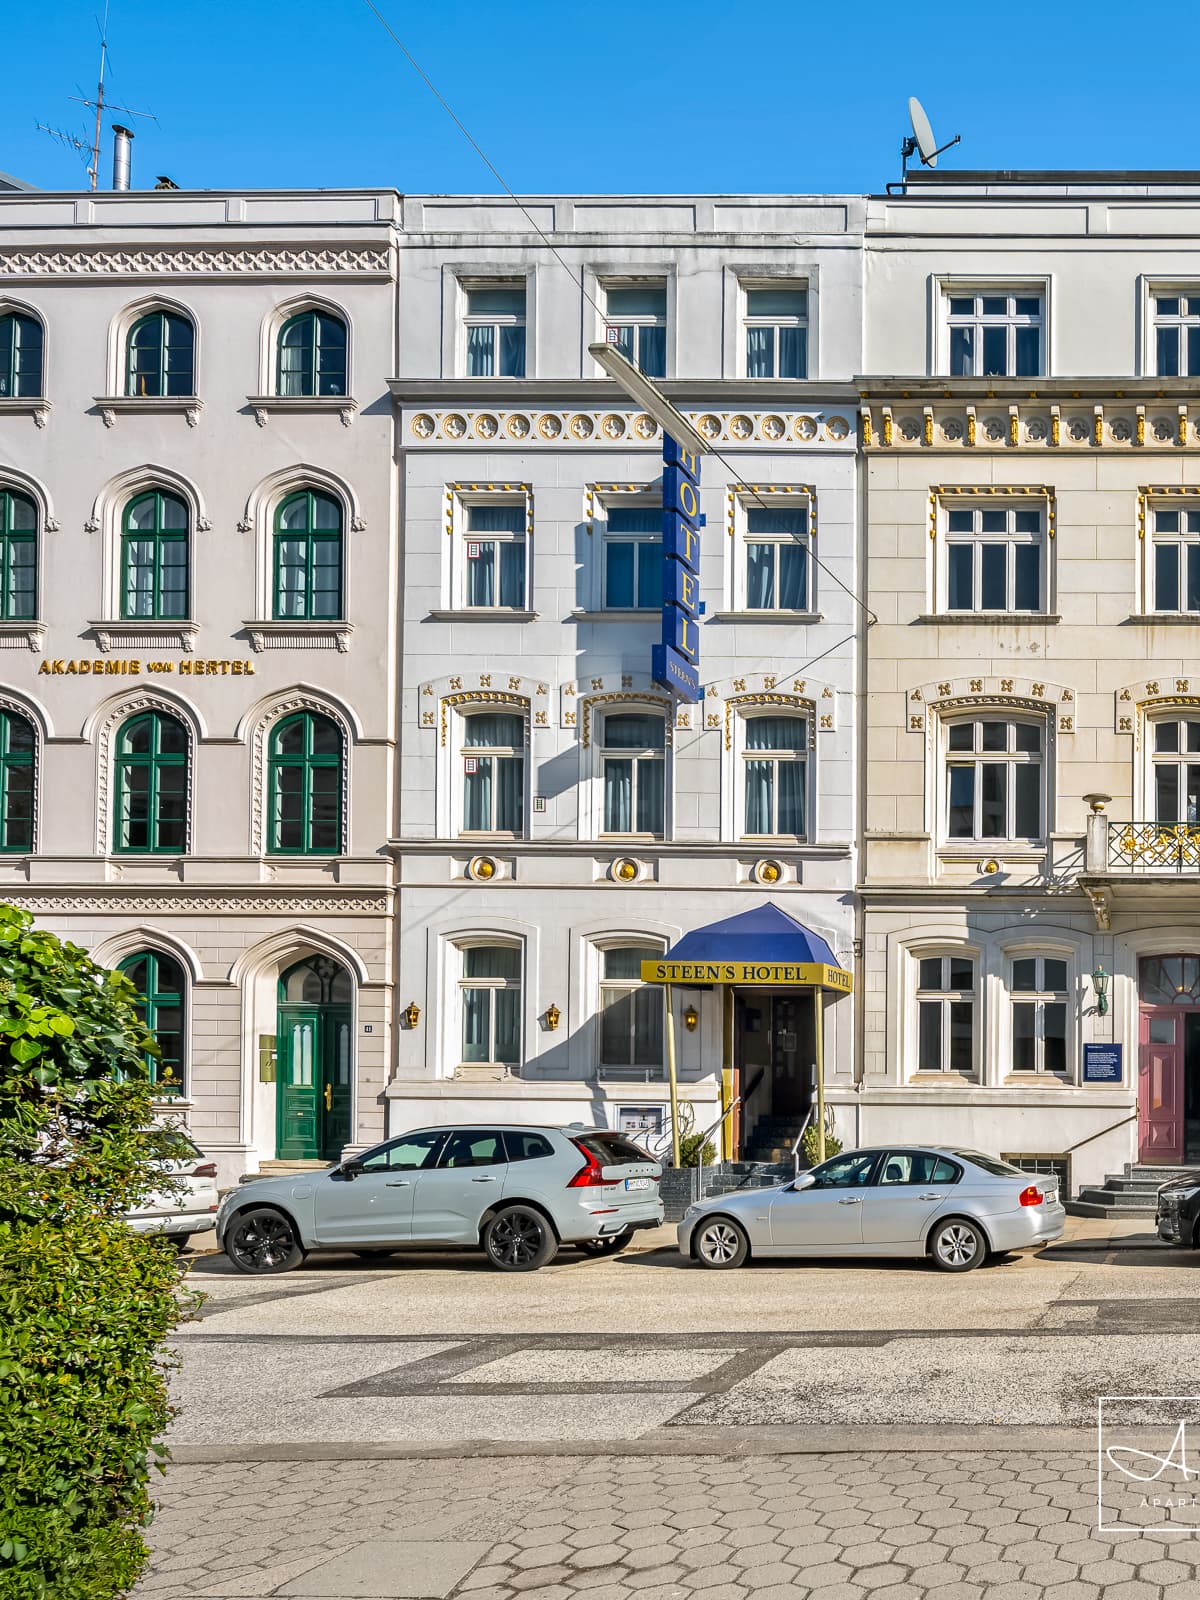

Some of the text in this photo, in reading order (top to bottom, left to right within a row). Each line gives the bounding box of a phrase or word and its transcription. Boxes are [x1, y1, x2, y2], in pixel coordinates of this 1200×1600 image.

[38, 660, 141, 675] AKADEMIE
[179, 660, 255, 675] HERTEL
[743, 966, 807, 981] HOTEL
[827, 968, 850, 988] HOTEL
